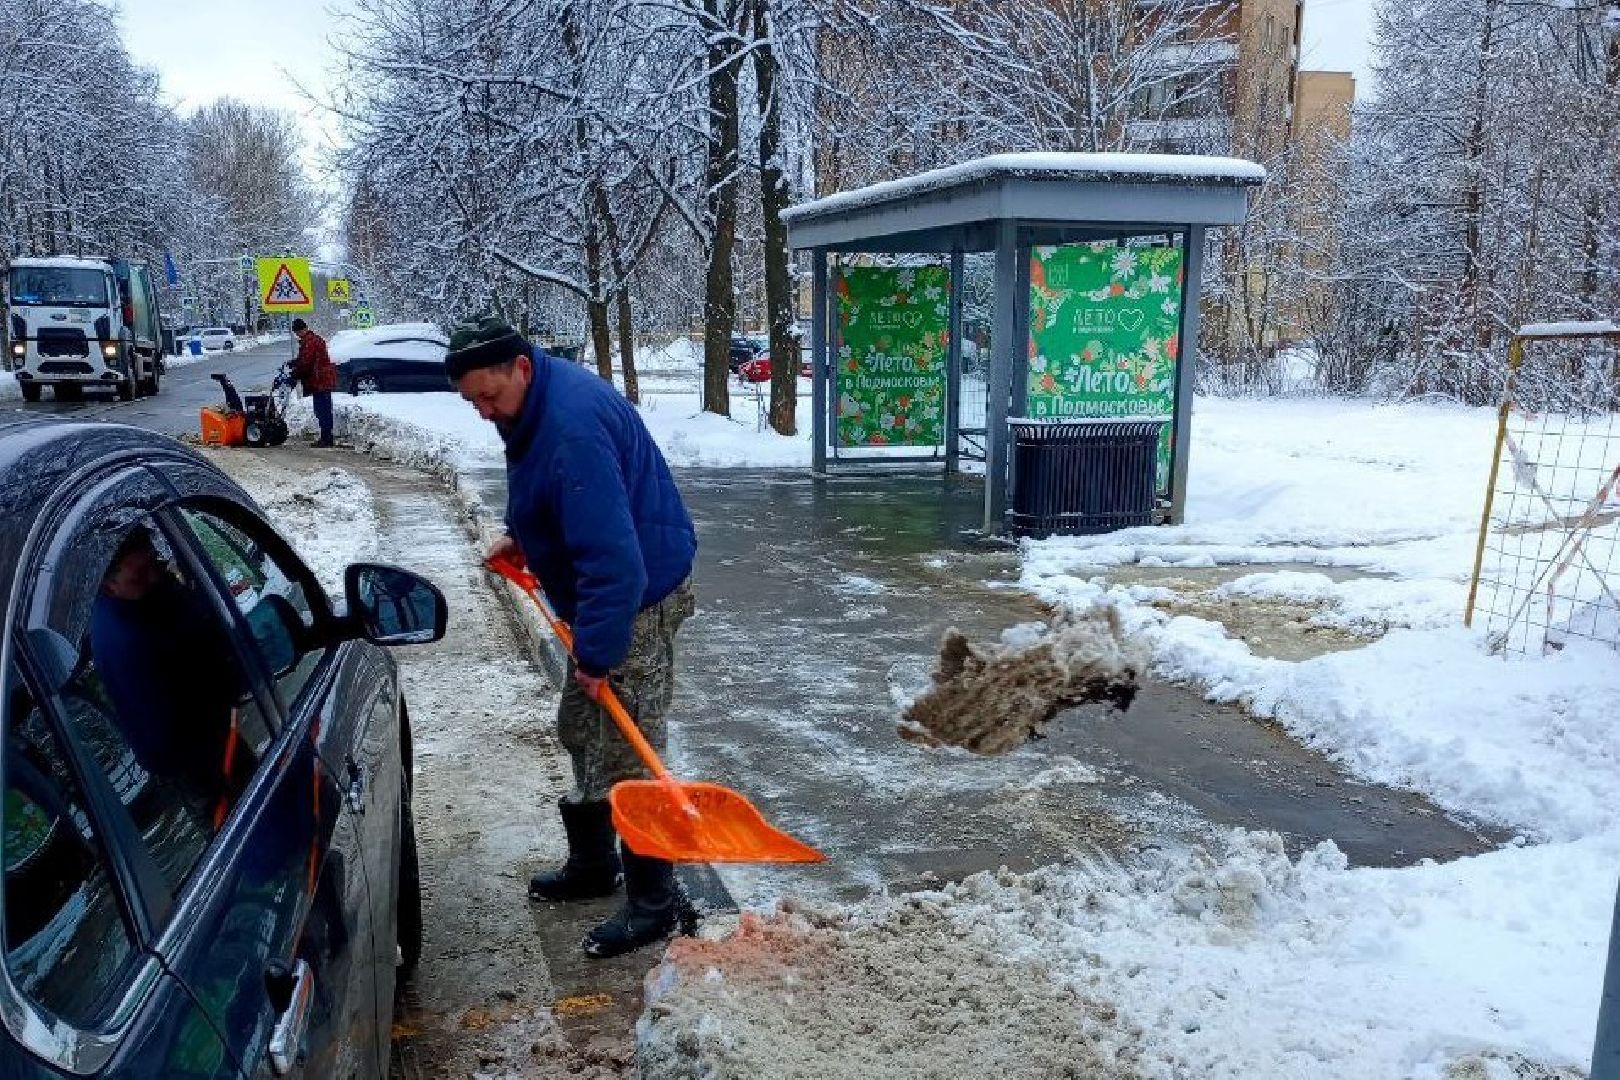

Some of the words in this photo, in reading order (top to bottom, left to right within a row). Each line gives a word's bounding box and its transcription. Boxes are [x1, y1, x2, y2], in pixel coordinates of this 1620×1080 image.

[870, 352, 913, 372] Лето
[845, 379, 853, 389] в
[856, 375, 940, 389] Подмосковье
[1071, 365, 1130, 393] Лето
[1036, 401, 1047, 415] в
[1052, 396, 1165, 415] Подмосковье
